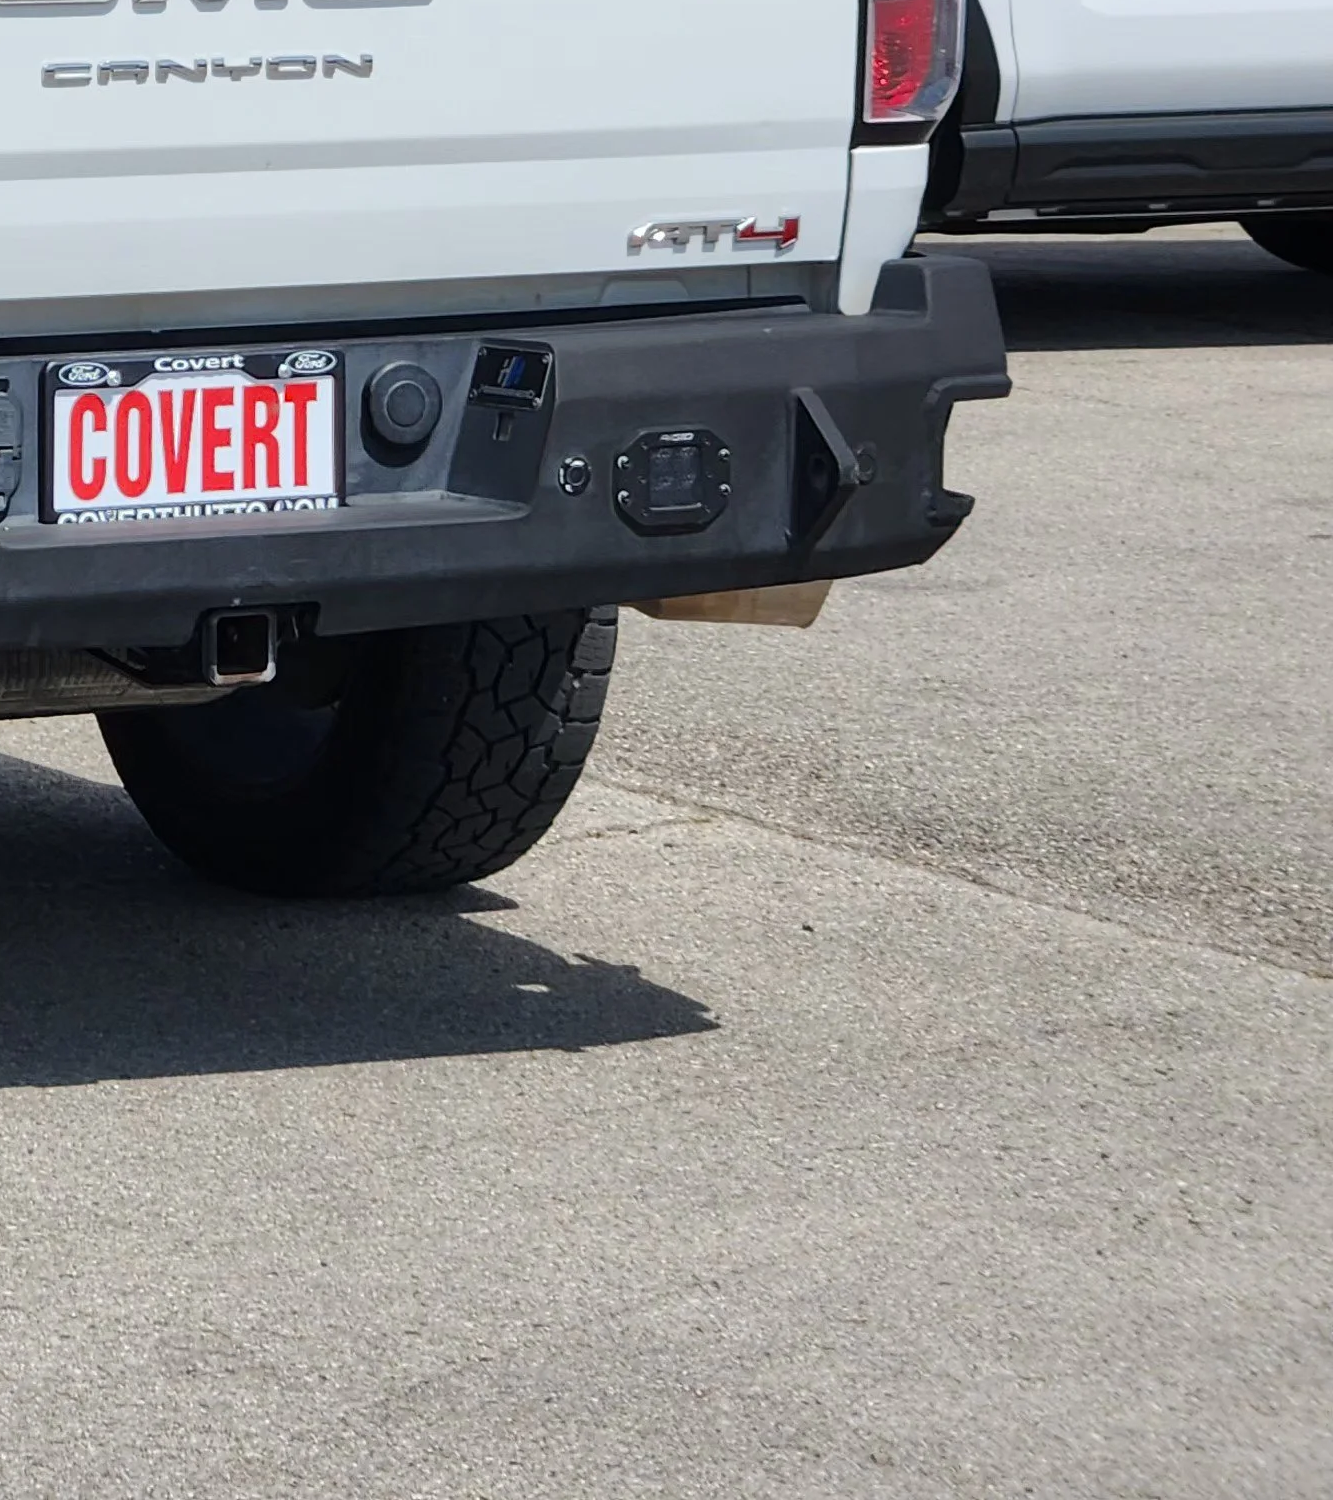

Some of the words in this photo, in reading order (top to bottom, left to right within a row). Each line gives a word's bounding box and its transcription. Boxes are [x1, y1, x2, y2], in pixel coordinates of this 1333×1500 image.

[40, 54, 374, 88] CANYON
[627, 216, 801, 253] AT4
[68, 365, 101, 381] Ford
[154, 352, 246, 372] Covert
[294, 353, 327, 369] Ford
[68, 383, 318, 501] COVERT
[57, 497, 339, 525] COVERTHUTTOCOM
